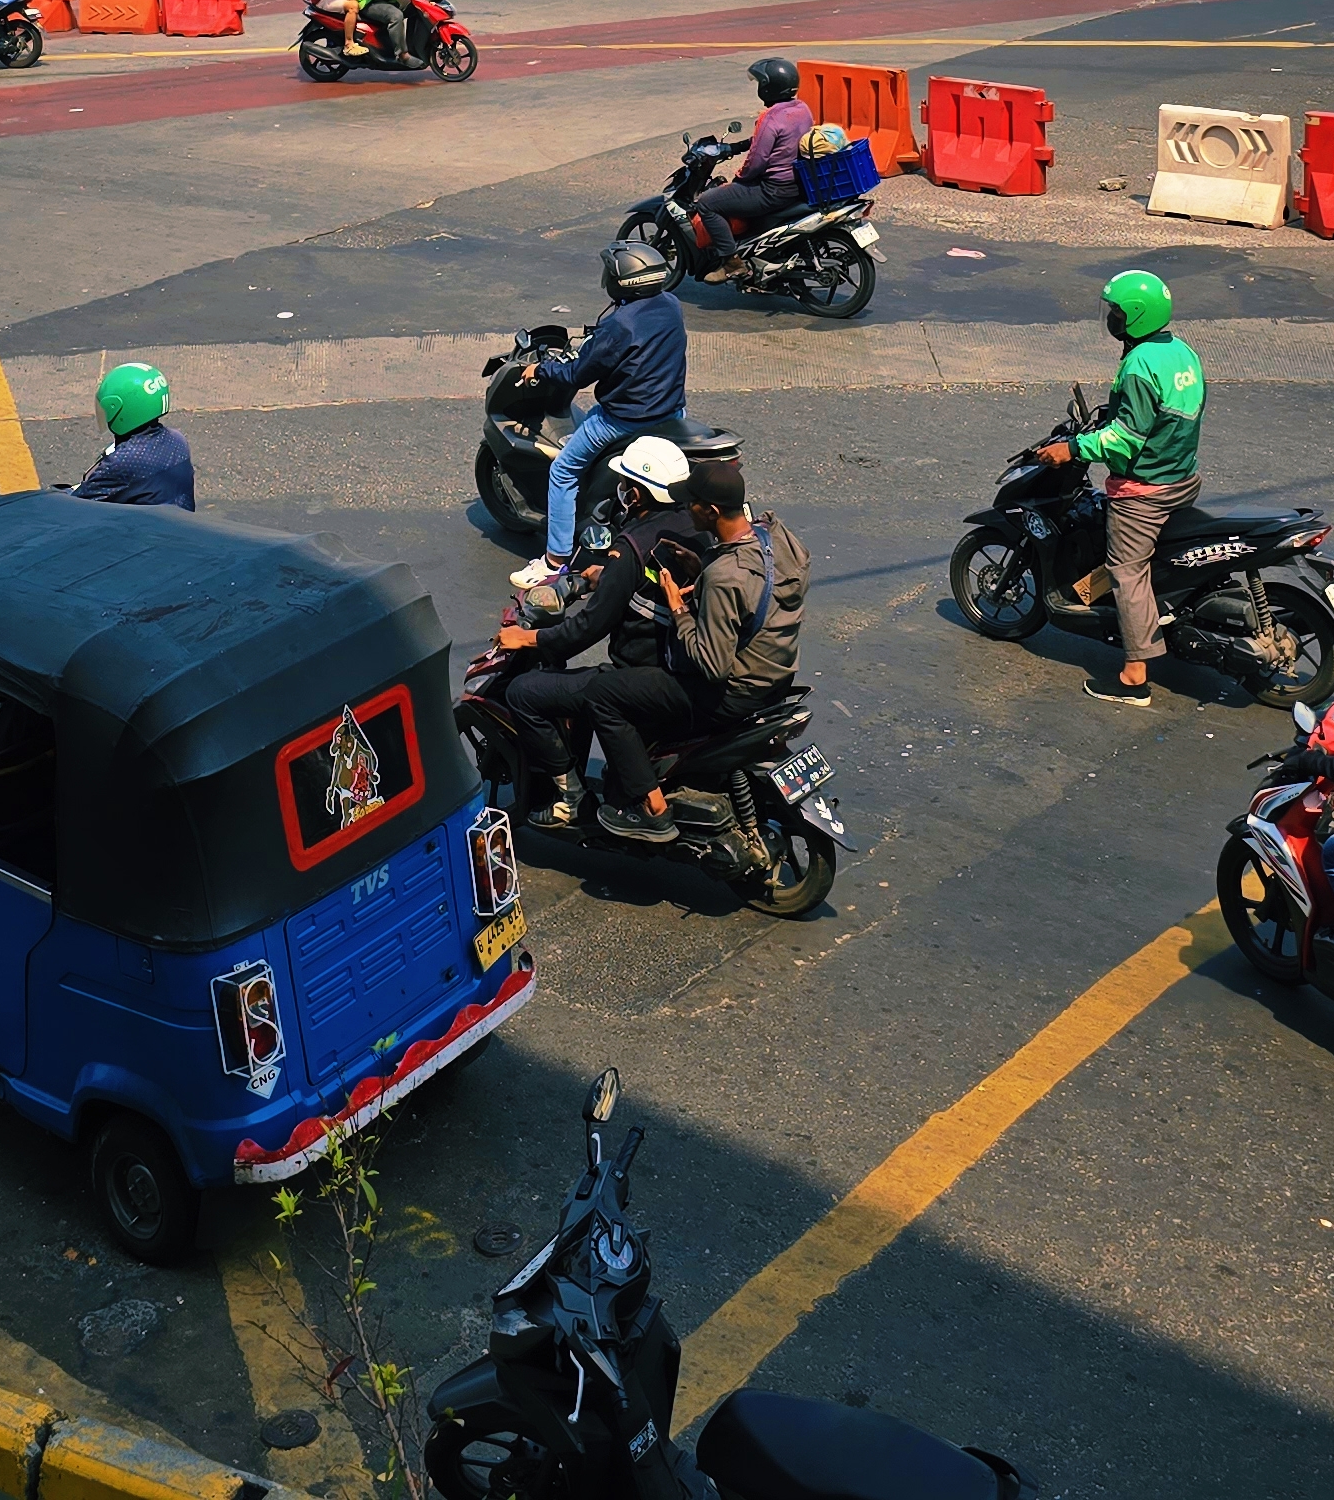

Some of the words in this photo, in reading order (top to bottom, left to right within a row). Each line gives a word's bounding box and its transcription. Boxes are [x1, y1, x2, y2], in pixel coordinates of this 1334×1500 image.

[1184, 542, 1244, 560] STREET
[774, 774, 786, 787] B
[784, 758, 807, 781] 5719
[350, 863, 389, 905] TVS
[477, 939, 484, 953] B
[251, 1069, 276, 1089] CNG
